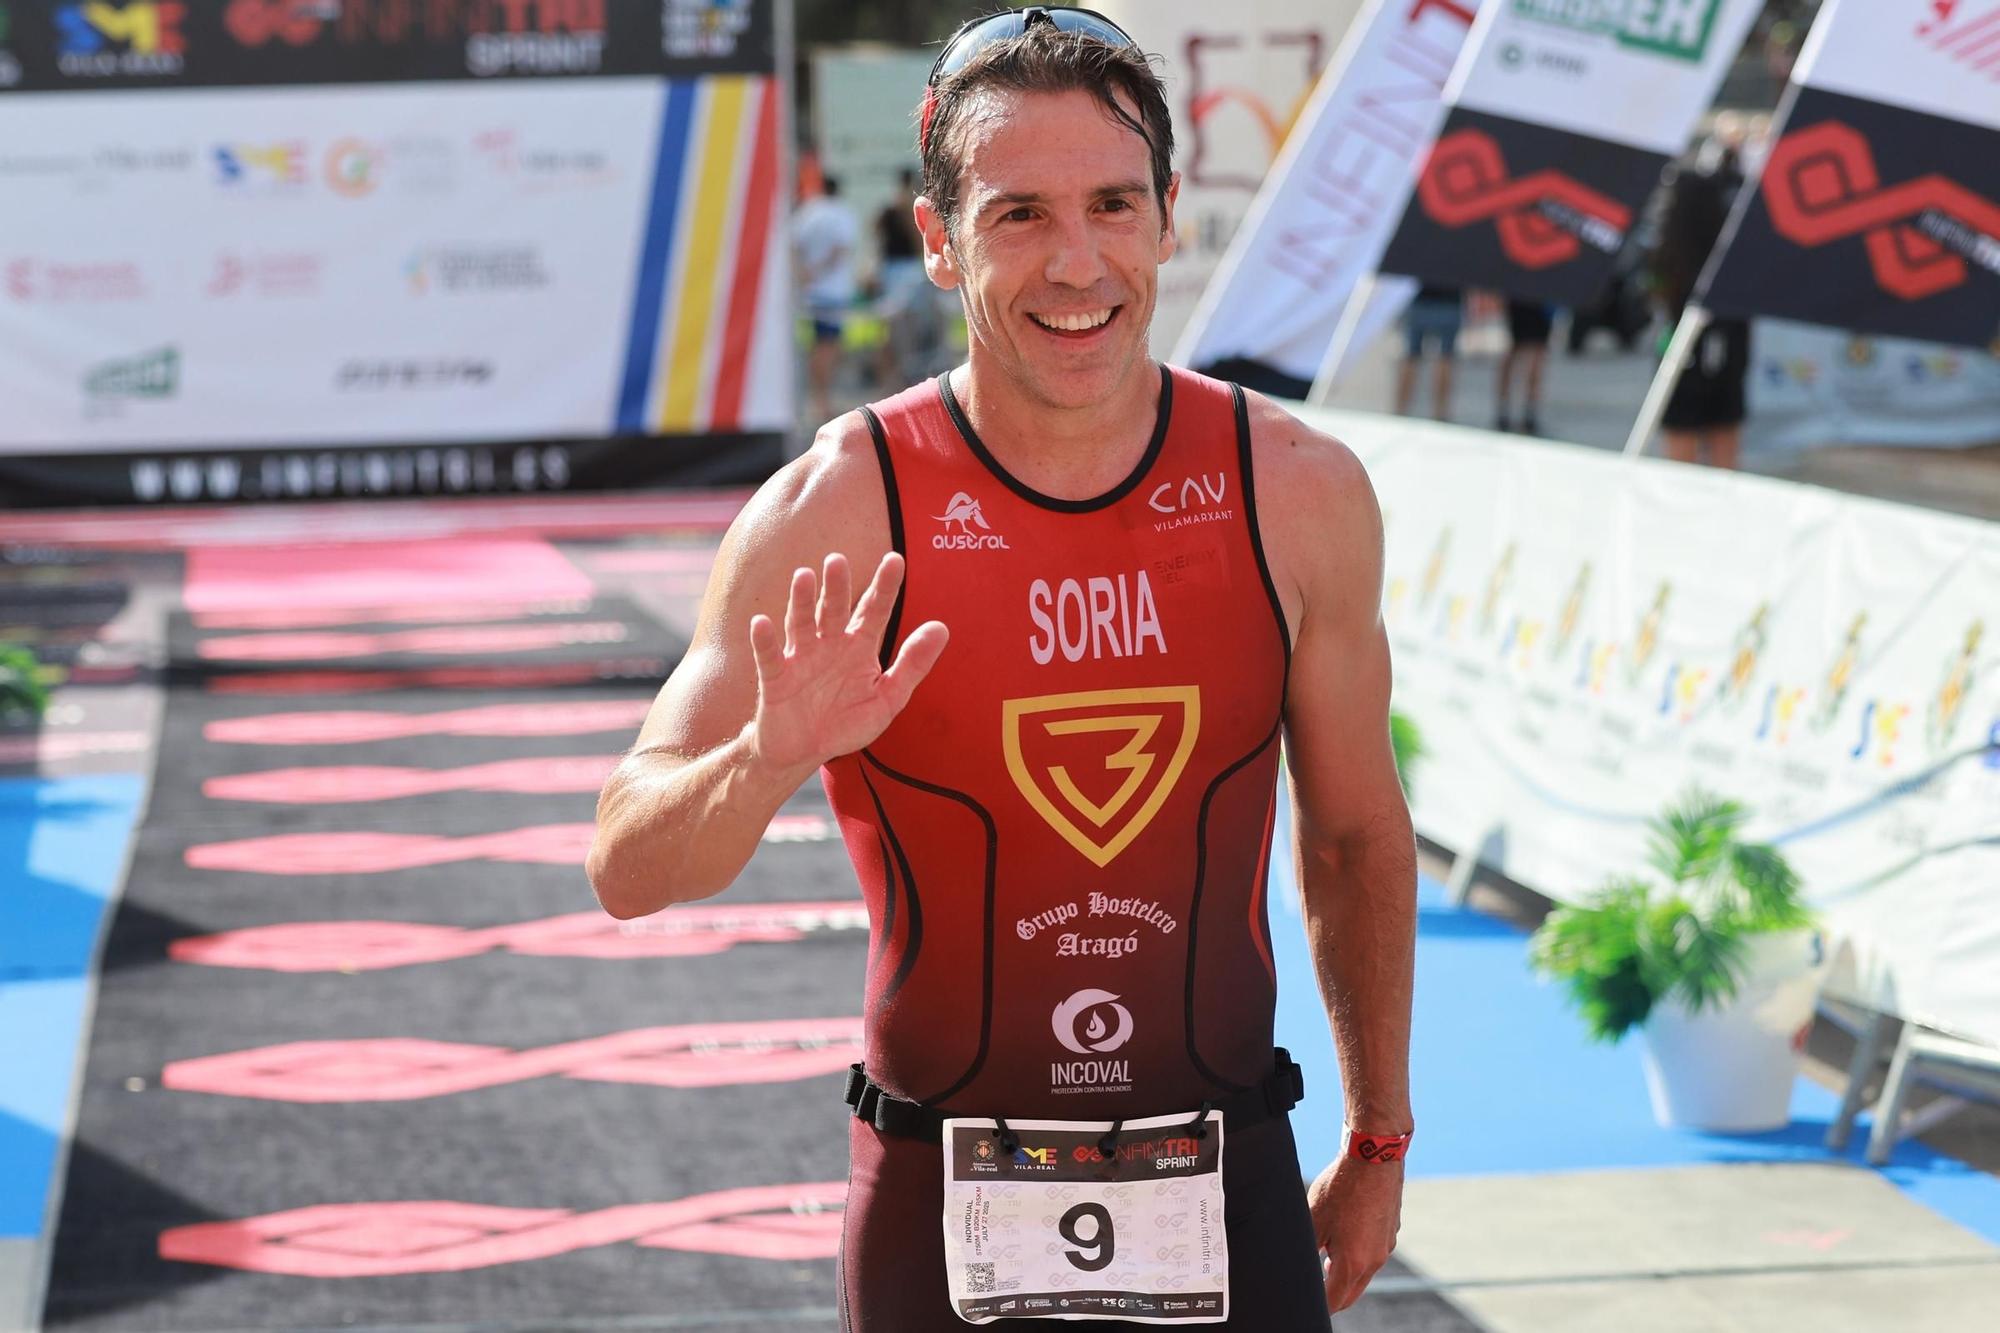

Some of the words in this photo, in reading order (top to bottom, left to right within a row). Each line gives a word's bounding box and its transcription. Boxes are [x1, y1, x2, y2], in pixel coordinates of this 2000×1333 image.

[1154, 510, 1233, 533] VILAMARXANT
[1029, 569, 1168, 665] SORIA
[1016, 902, 1079, 941] Grupo
[1088, 891, 1177, 934] Hostelero
[1055, 929, 1139, 959] Aragó
[1051, 1060, 1133, 1085] INCOVAL
[1156, 1156, 1198, 1170] SPRINT
[965, 1200, 973, 1243] INDIVIDUAL
[1058, 1202, 1115, 1272] 9
[1200, 1198, 1211, 1274] www.infinitri.es
